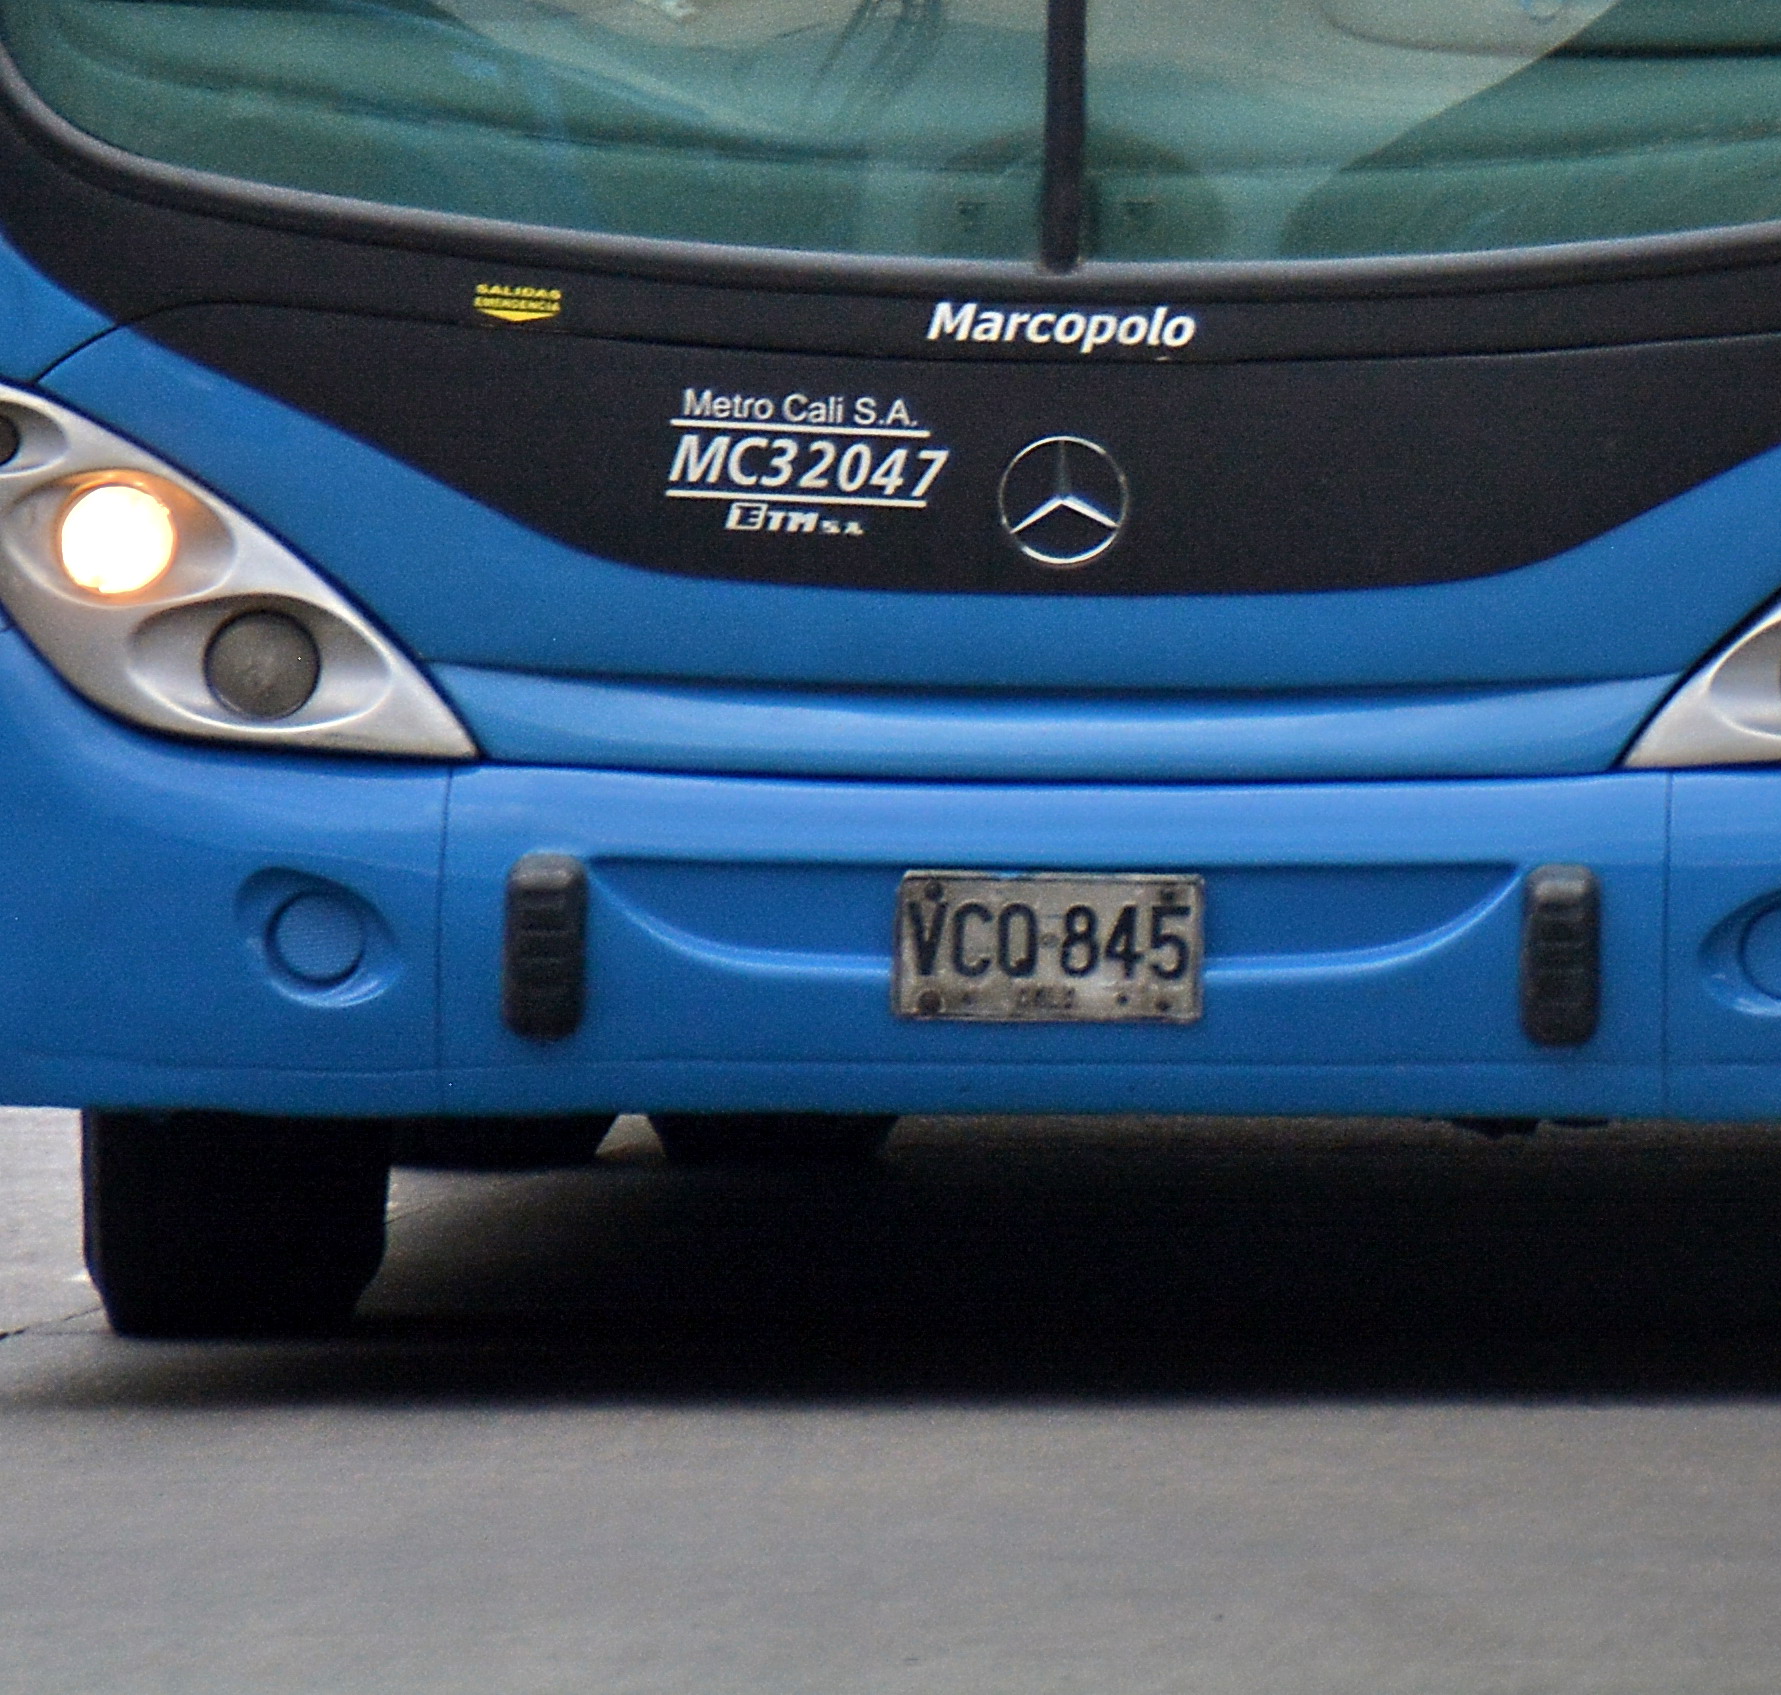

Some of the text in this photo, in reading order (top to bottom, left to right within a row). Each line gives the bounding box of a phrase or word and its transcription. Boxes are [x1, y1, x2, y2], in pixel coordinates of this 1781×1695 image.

[926, 302, 1197, 354] Marcopolo
[683, 387, 918, 427] Metro Cali S.A.
[668, 434, 949, 498] MC32047
